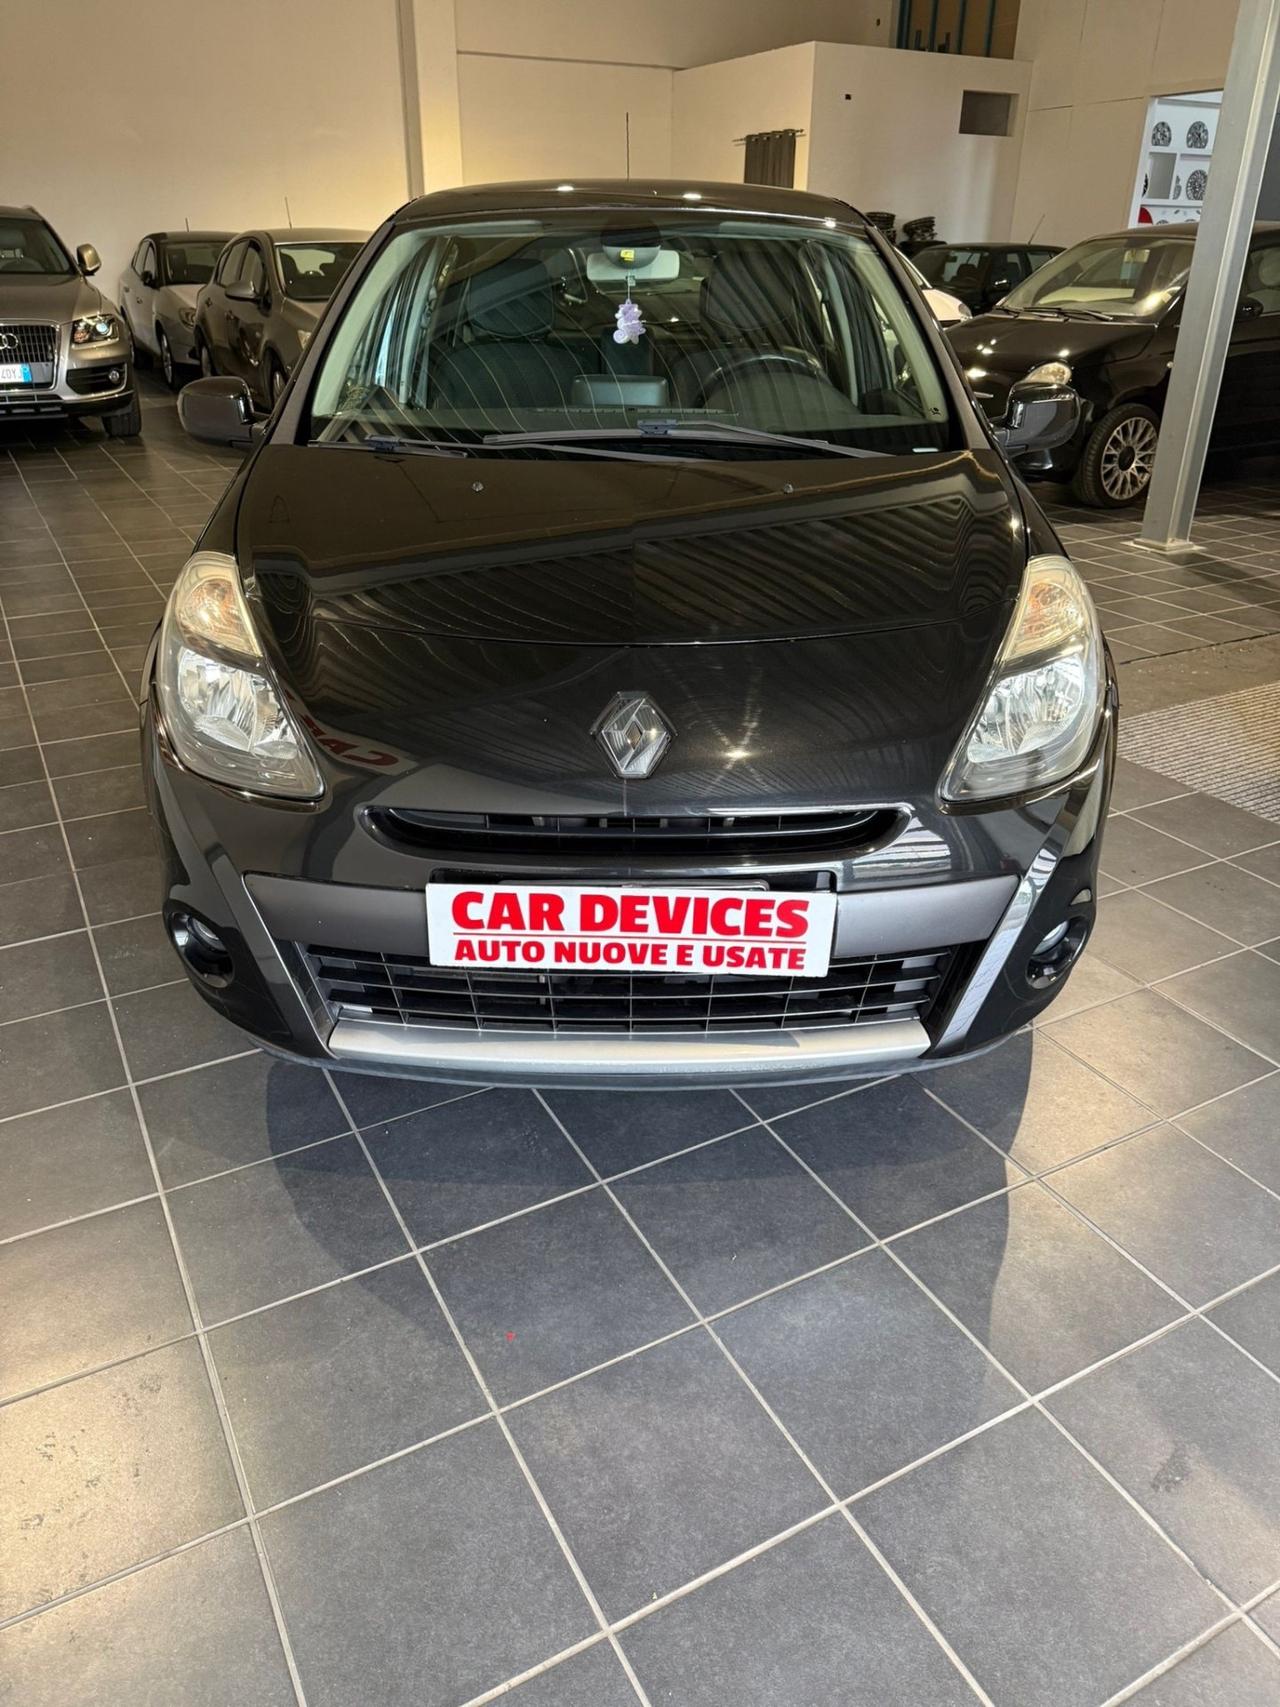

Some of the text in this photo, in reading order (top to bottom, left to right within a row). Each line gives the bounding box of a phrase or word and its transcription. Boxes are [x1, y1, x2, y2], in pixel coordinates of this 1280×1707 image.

[451, 890, 810, 939] CAR DEVICES
[454, 939, 806, 970] AUTO NUOVE E USATE
